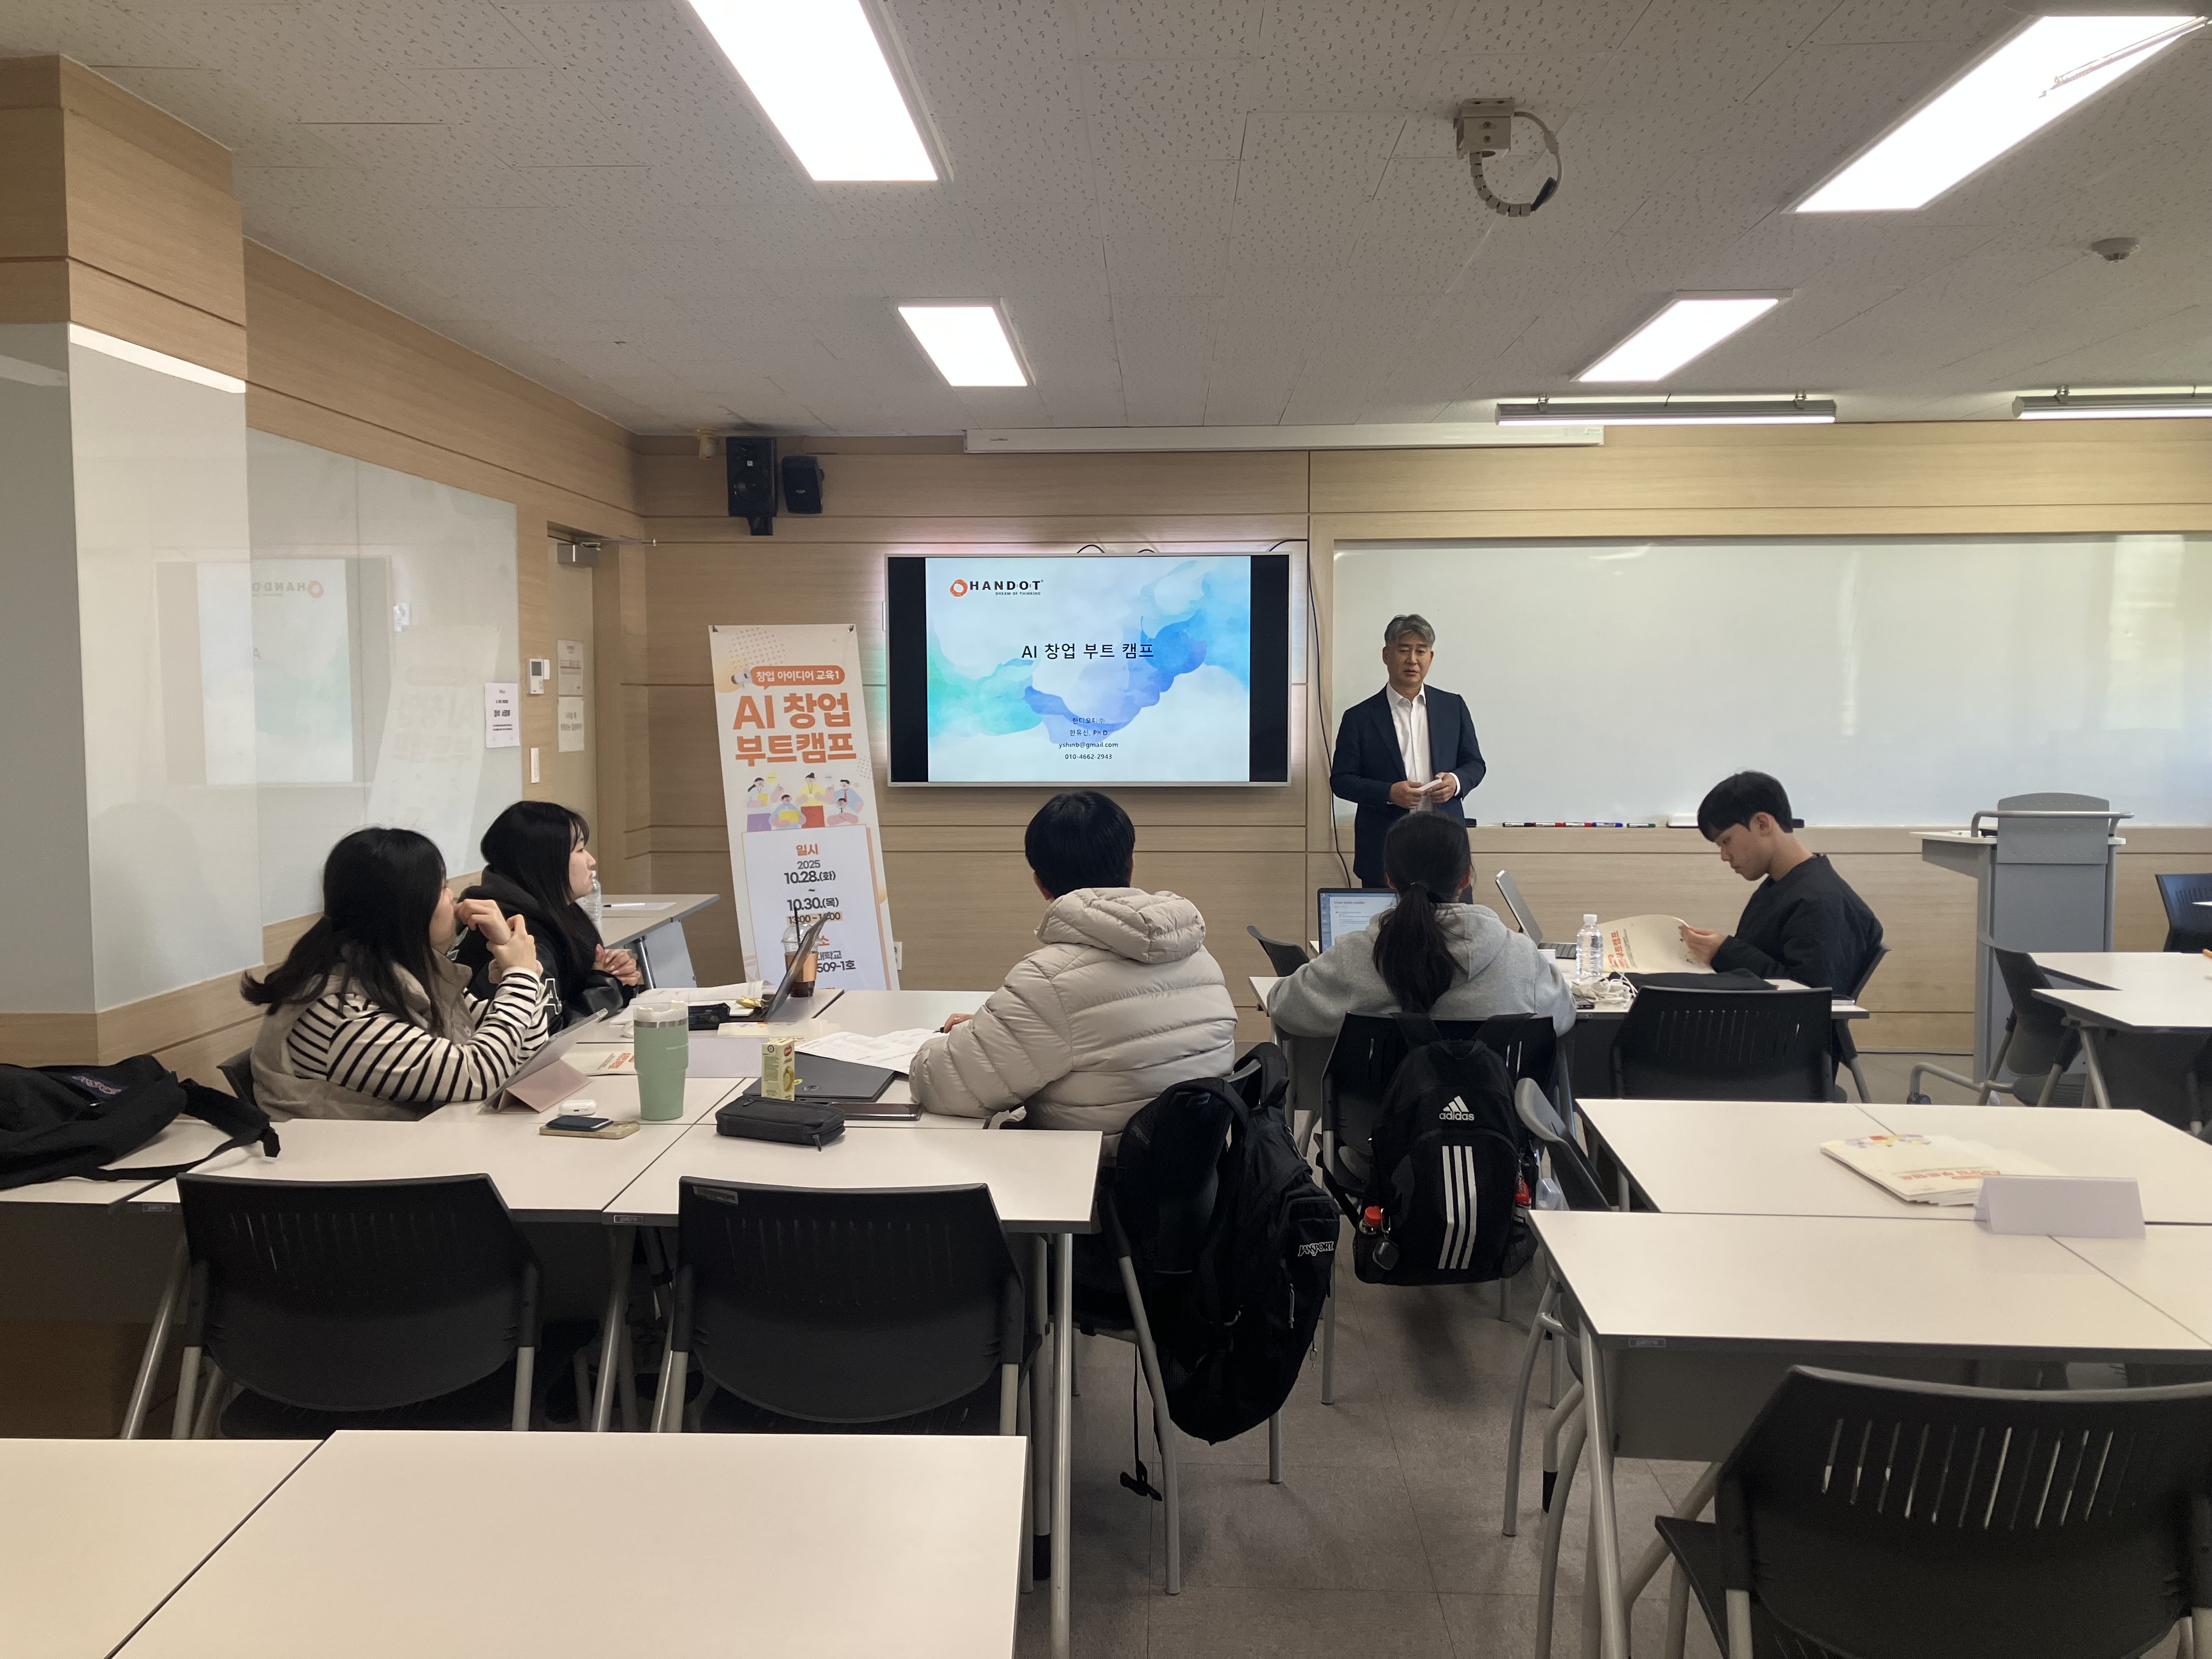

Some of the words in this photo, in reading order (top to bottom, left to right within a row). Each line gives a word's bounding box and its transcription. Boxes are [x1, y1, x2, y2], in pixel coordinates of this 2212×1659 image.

[1021, 645, 1037, 658] AI
[1045, 643, 1075, 659] 창업
[1083, 644, 1115, 659] 부트
[1122, 642, 1154, 659] 캠프
[756, 670, 775, 682] 창업
[777, 670, 814, 681] 아이디어
[816, 670, 839, 681] 교육1
[733, 695, 775, 730] AI
[783, 692, 851, 729] 창업
[735, 732, 856, 766] 부트캠프
[796, 843, 819, 856] 일시
[797, 859, 821, 870] 2025
[784, 870, 836, 884] 10.28.(화)
[787, 897, 839, 911] 10.30.(목)
[818, 935, 830, 946] 소
[816, 960, 856, 973] 509-1호
[1439, 1110, 1475, 1121] adidas
[1297, 1241, 1334, 1257] JANSPORT
